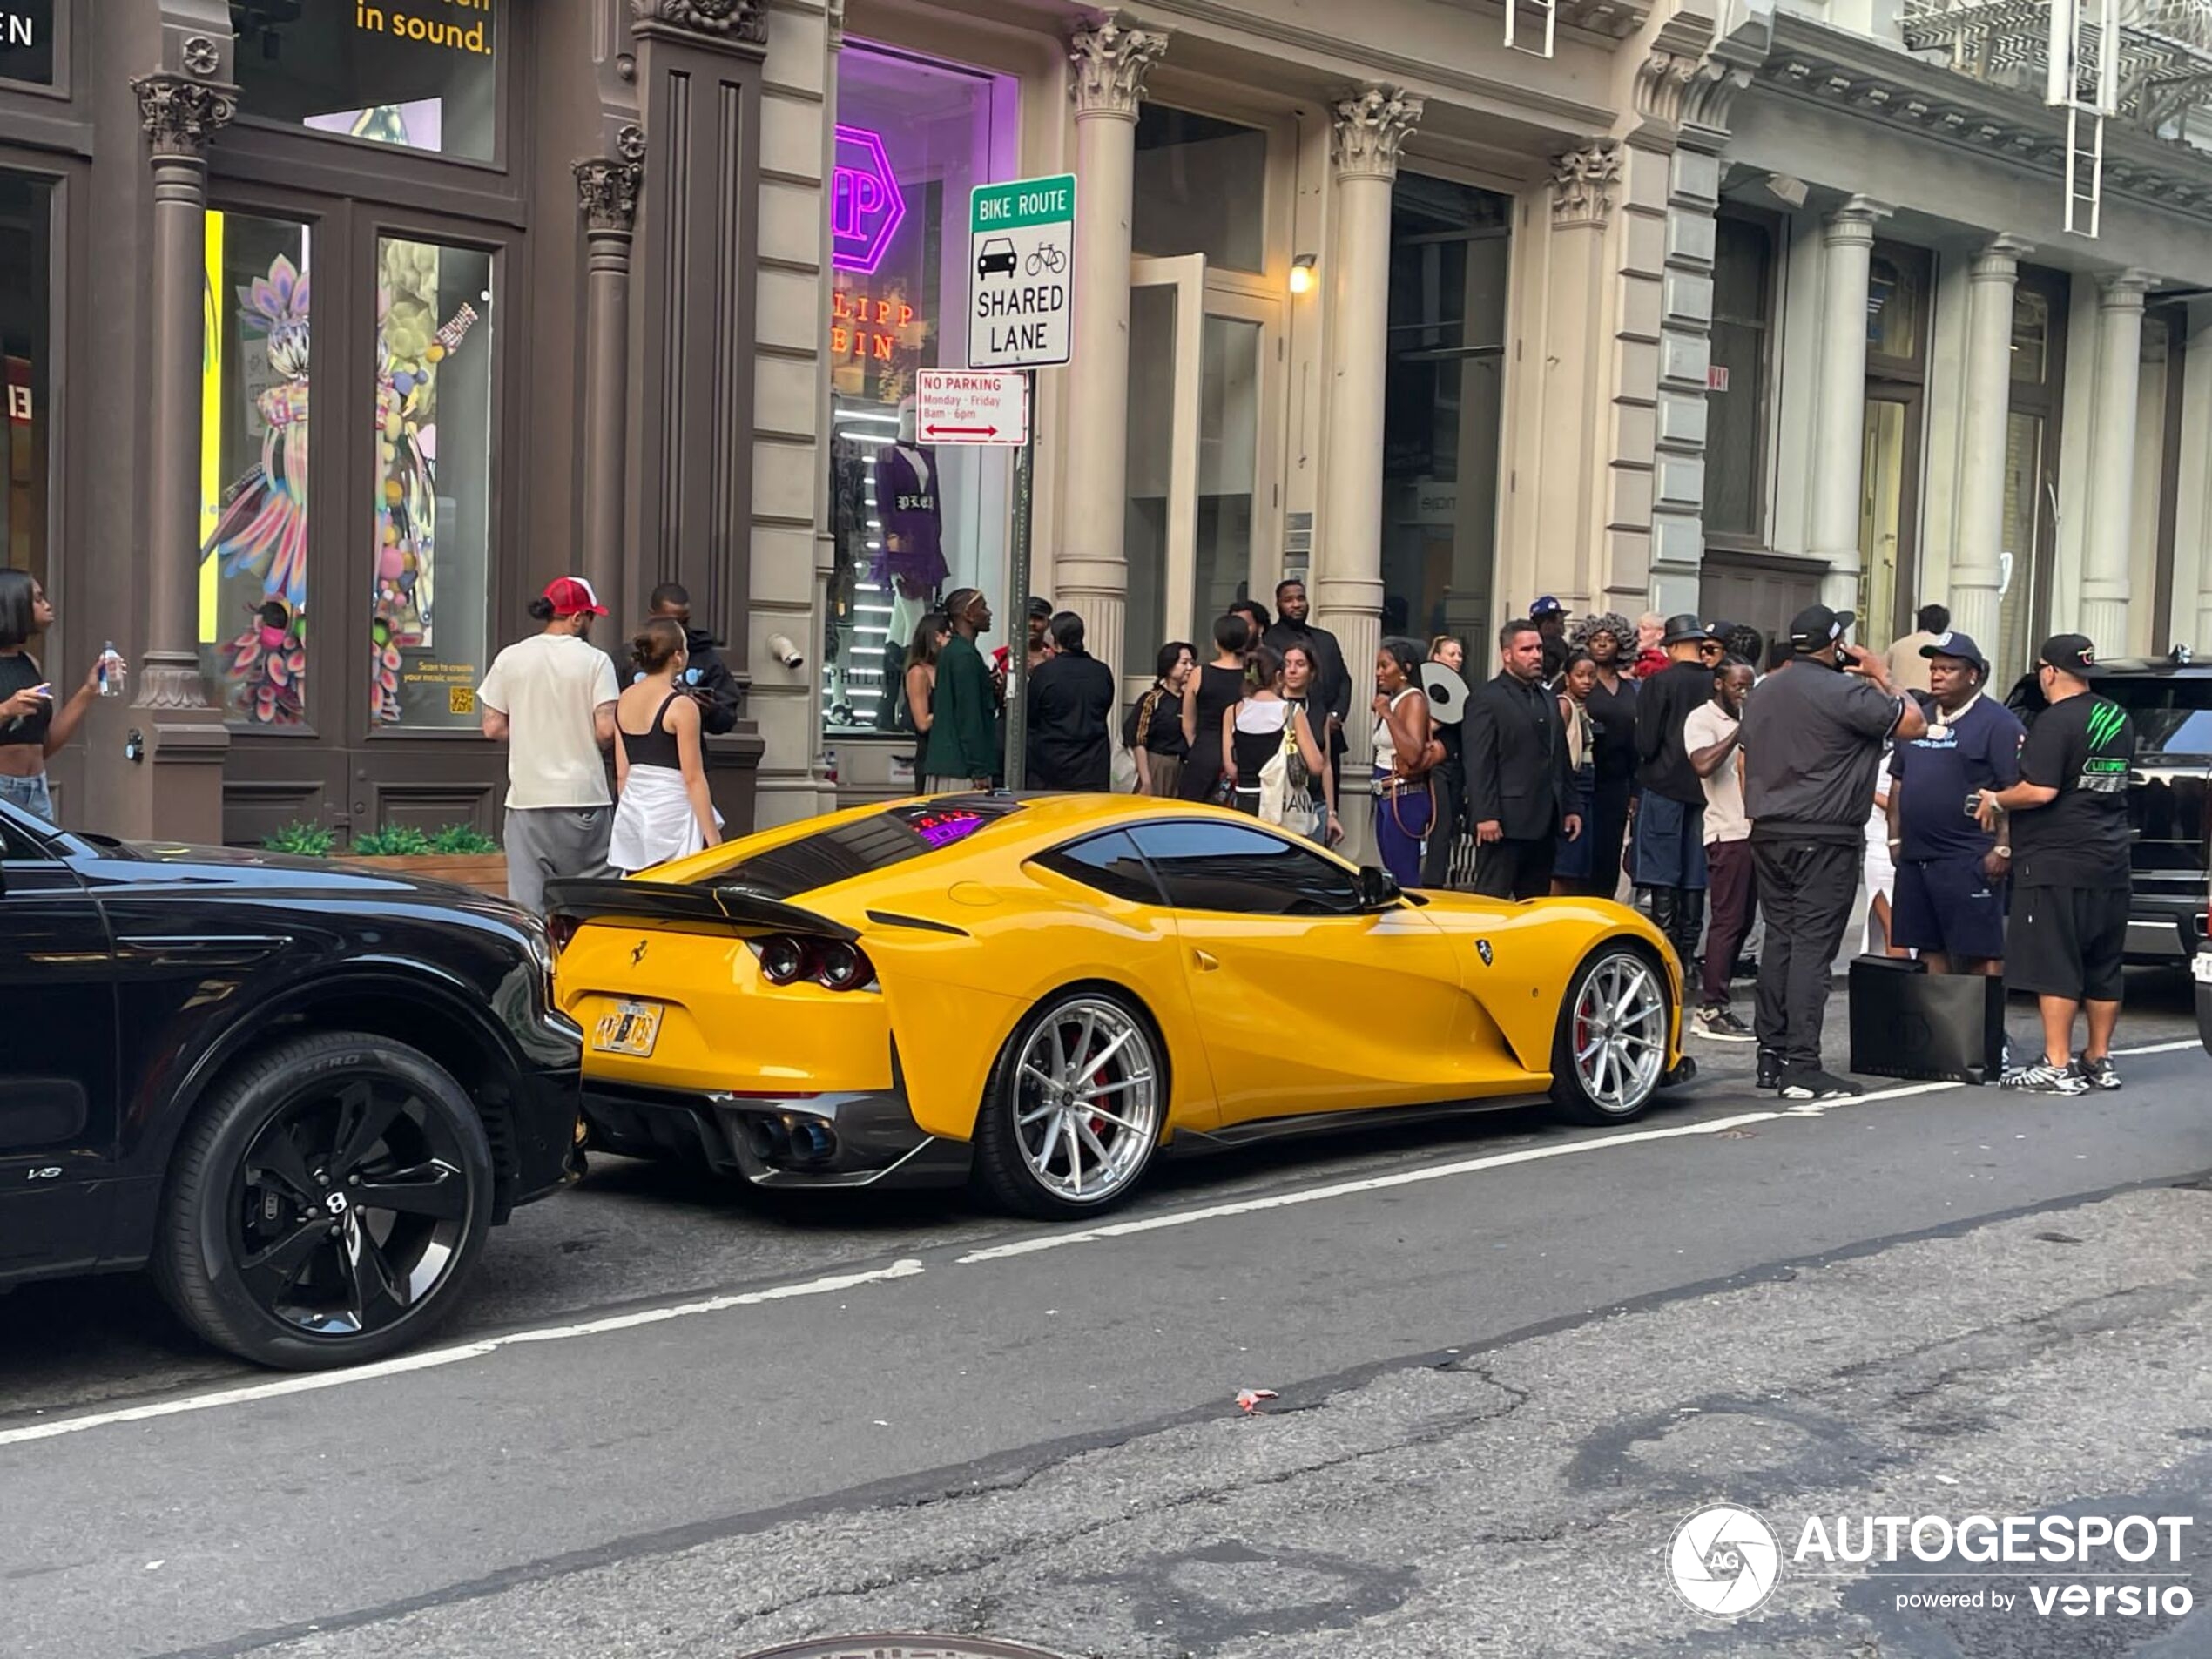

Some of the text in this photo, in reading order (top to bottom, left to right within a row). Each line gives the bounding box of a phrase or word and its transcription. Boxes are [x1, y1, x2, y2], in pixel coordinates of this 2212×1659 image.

[357, 0, 492, 55] in sound.
[979, 189, 1067, 221] BIKE ROUTE
[977, 285, 1064, 318] SHARED
[991, 323, 1048, 354] LANE
[924, 377, 1001, 391] NO PARKING
[924, 395, 961, 407] Monday
[970, 395, 1001, 408] Friday
[924, 408, 945, 419] 8am
[954, 409, 976, 421] 6pm
